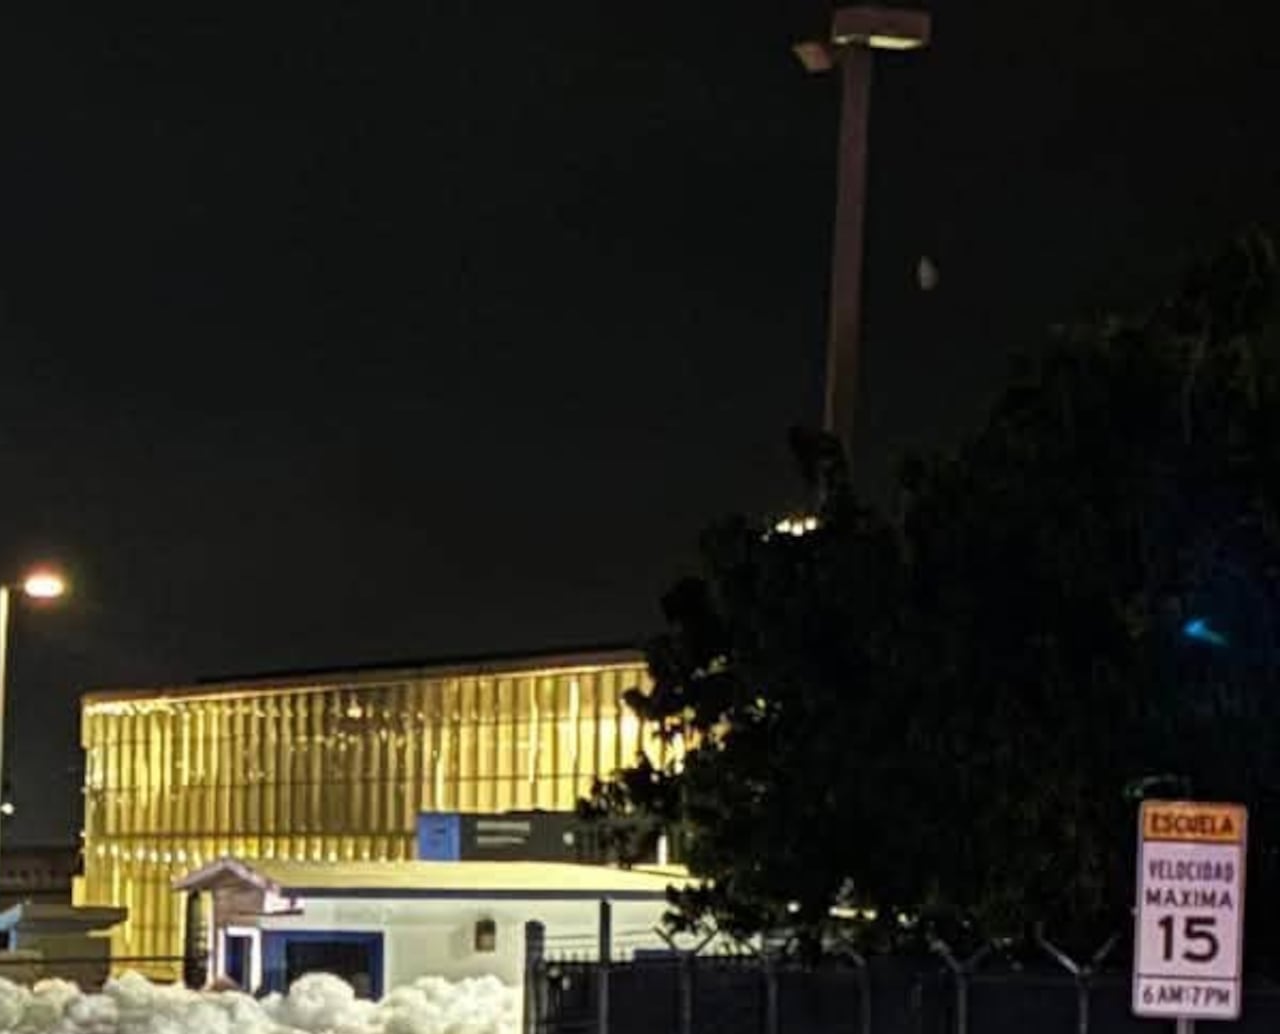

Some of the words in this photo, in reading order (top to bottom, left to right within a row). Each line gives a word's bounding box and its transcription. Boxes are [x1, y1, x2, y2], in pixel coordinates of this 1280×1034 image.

[1151, 811, 1234, 835] ESCUELA
[1148, 859, 1234, 884] VELOCIDAD
[1145, 887, 1234, 910] MAXIMA
[1157, 915, 1220, 963] 15
